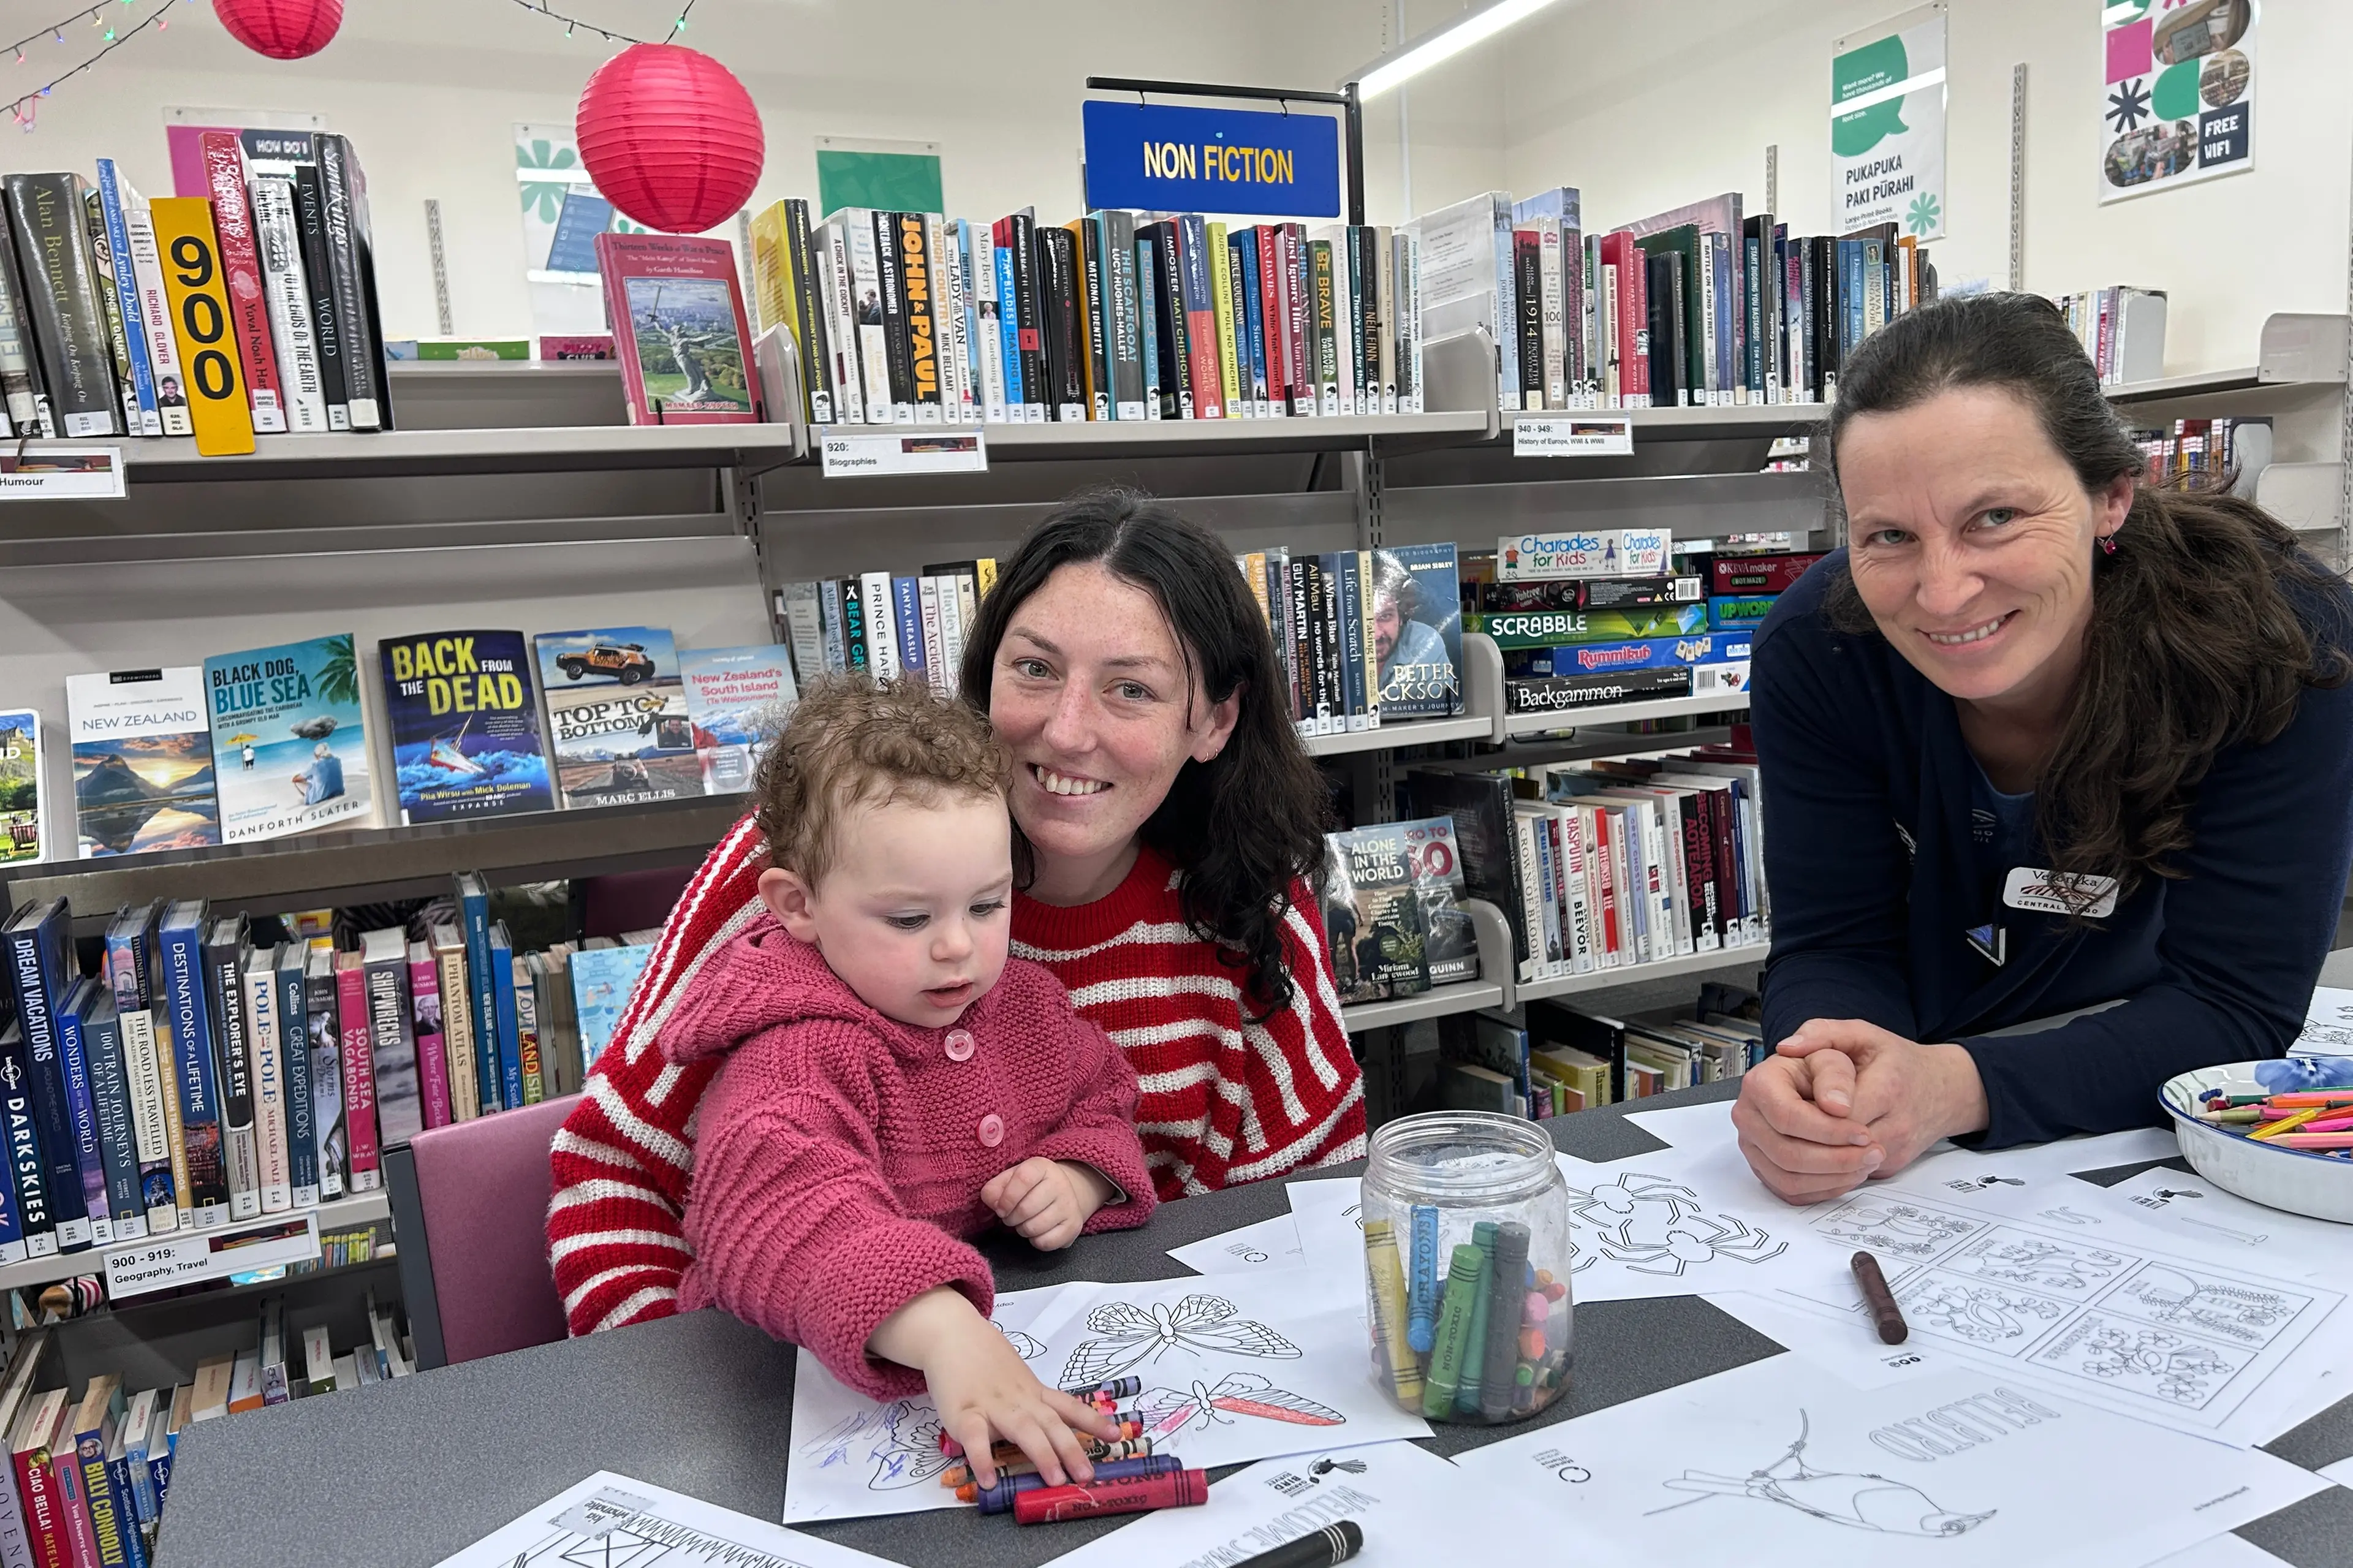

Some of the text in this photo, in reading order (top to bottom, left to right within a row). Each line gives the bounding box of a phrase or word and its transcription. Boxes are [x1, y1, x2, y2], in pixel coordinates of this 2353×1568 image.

[256, 140, 281, 153] HOW
[283, 140, 299, 153] DO
[2205, 115, 2241, 137] FREE
[1143, 142, 1294, 184] NON FICTION
[1846, 155, 1902, 184] PUKAPUKA
[2204, 140, 2230, 160] WIFI
[1846, 175, 1914, 208] PAKI PŪRAHI
[1875, 206, 1892, 216] Books
[35, 186, 68, 303] Alan Bennett
[979, 231, 993, 297] Mary Berry
[302, 184, 336, 357] EVENTS WORLD
[1706, 275, 1712, 286] ON
[146, 290, 170, 365] RICHARD GLOVER
[170, 236, 235, 400] 900
[901, 218, 936, 400] JOHN & PAUL
[931, 222, 955, 392] TOUGH COUNTRY MIKE BELLAMY
[1088, 260, 1102, 355] NATIONAL IDENTITY
[1112, 248, 1126, 362] LUCY HUGHES-HALLETT
[1121, 249, 1137, 363] THE SCAPEGOAT
[1166, 235, 1189, 388] IMPOSTER MATT CHISHOLM
[1525, 298, 1538, 338] 1914
[1366, 311, 1377, 362] NEIL FINN
[827, 442, 849, 453] 920:
[829, 456, 877, 467] Biographies
[1518, 437, 1539, 447] History
[1547, 437, 1570, 447] Europe,
[0, 477, 44, 486] Humour
[1521, 532, 1662, 554] Charades Charades
[1533, 553, 1587, 567] for Kids
[1629, 552, 1640, 564] for
[1292, 563, 1308, 640] GUY MARTIN
[1344, 569, 1358, 593] Life
[871, 584, 887, 640] PRINCE
[901, 581, 917, 664] TANYA HEASLIP
[1491, 615, 1588, 637] SCRABBLE
[392, 637, 513, 681] BACK FROM
[1347, 618, 1362, 664] Scratch
[1577, 645, 1652, 669] Rummikub
[212, 657, 300, 688] BLACK DOG,
[214, 675, 312, 714] BLUE SEA
[400, 673, 523, 717] THE DEAD
[701, 678, 778, 695] South Island
[1393, 663, 1458, 683] PETER
[554, 697, 651, 727] TOP TO
[1518, 684, 1623, 708] Backgammon
[82, 710, 197, 731] NEW ZEALAND
[558, 714, 645, 740] BOTTOM
[229, 801, 360, 841] DANFORTH SLATER
[1696, 791, 1714, 881] BECOMING
[1351, 838, 1397, 855] ALONE
[1354, 853, 1398, 869] IN THE
[1566, 817, 1583, 874] RASPUTIN
[1685, 817, 1705, 910] AOTEAROA
[1351, 865, 1404, 884] WORLD
[1520, 828, 1540, 960] CROWN OF BLOOD
[2017, 900, 2062, 911] CENTRAL
[1574, 901, 1587, 956] BEEVOR
[1428, 961, 1465, 974] QUINN
[15, 939, 53, 1062] DREAM VACATIONS
[173, 943, 196, 1039] DESTINATIONS
[370, 969, 402, 1048] SHIPWRECKS
[187, 1040, 195, 1051] OF
[223, 961, 246, 1097] THE EXPLORER'S EYE
[254, 980, 277, 1104] POLE POLE
[288, 982, 310, 1140] Collins GREAT EXPEDITIONS
[343, 1029, 360, 1111] VAGABONDS
[355, 1026, 373, 1110] SOUTH SEA
[64, 1025, 94, 1154] WONDERS WORLD
[100, 1031, 132, 1168] 100 TRAIN JOURNEYS
[135, 1015, 164, 1156] THE ROAD LESS TRAVELLED
[186, 1061, 205, 1113] LIFETIME
[7, 1097, 45, 1224] DARK SKIES
[112, 1256, 135, 1269] 900
[148, 1249, 176, 1262] 919:
[115, 1258, 208, 1285] Geography, Travel
[1442, 1306, 1462, 1372] NON-TOXIC
[1869, 1386, 2062, 1463] BELLBIRD
[1273, 1475, 1302, 1491] BIRD
[28, 1468, 57, 1556] CIAO BELLA! KATE
[84, 1460, 124, 1566] BILLY CONNOLLY
[1243, 1485, 1381, 1550] WELCOME
